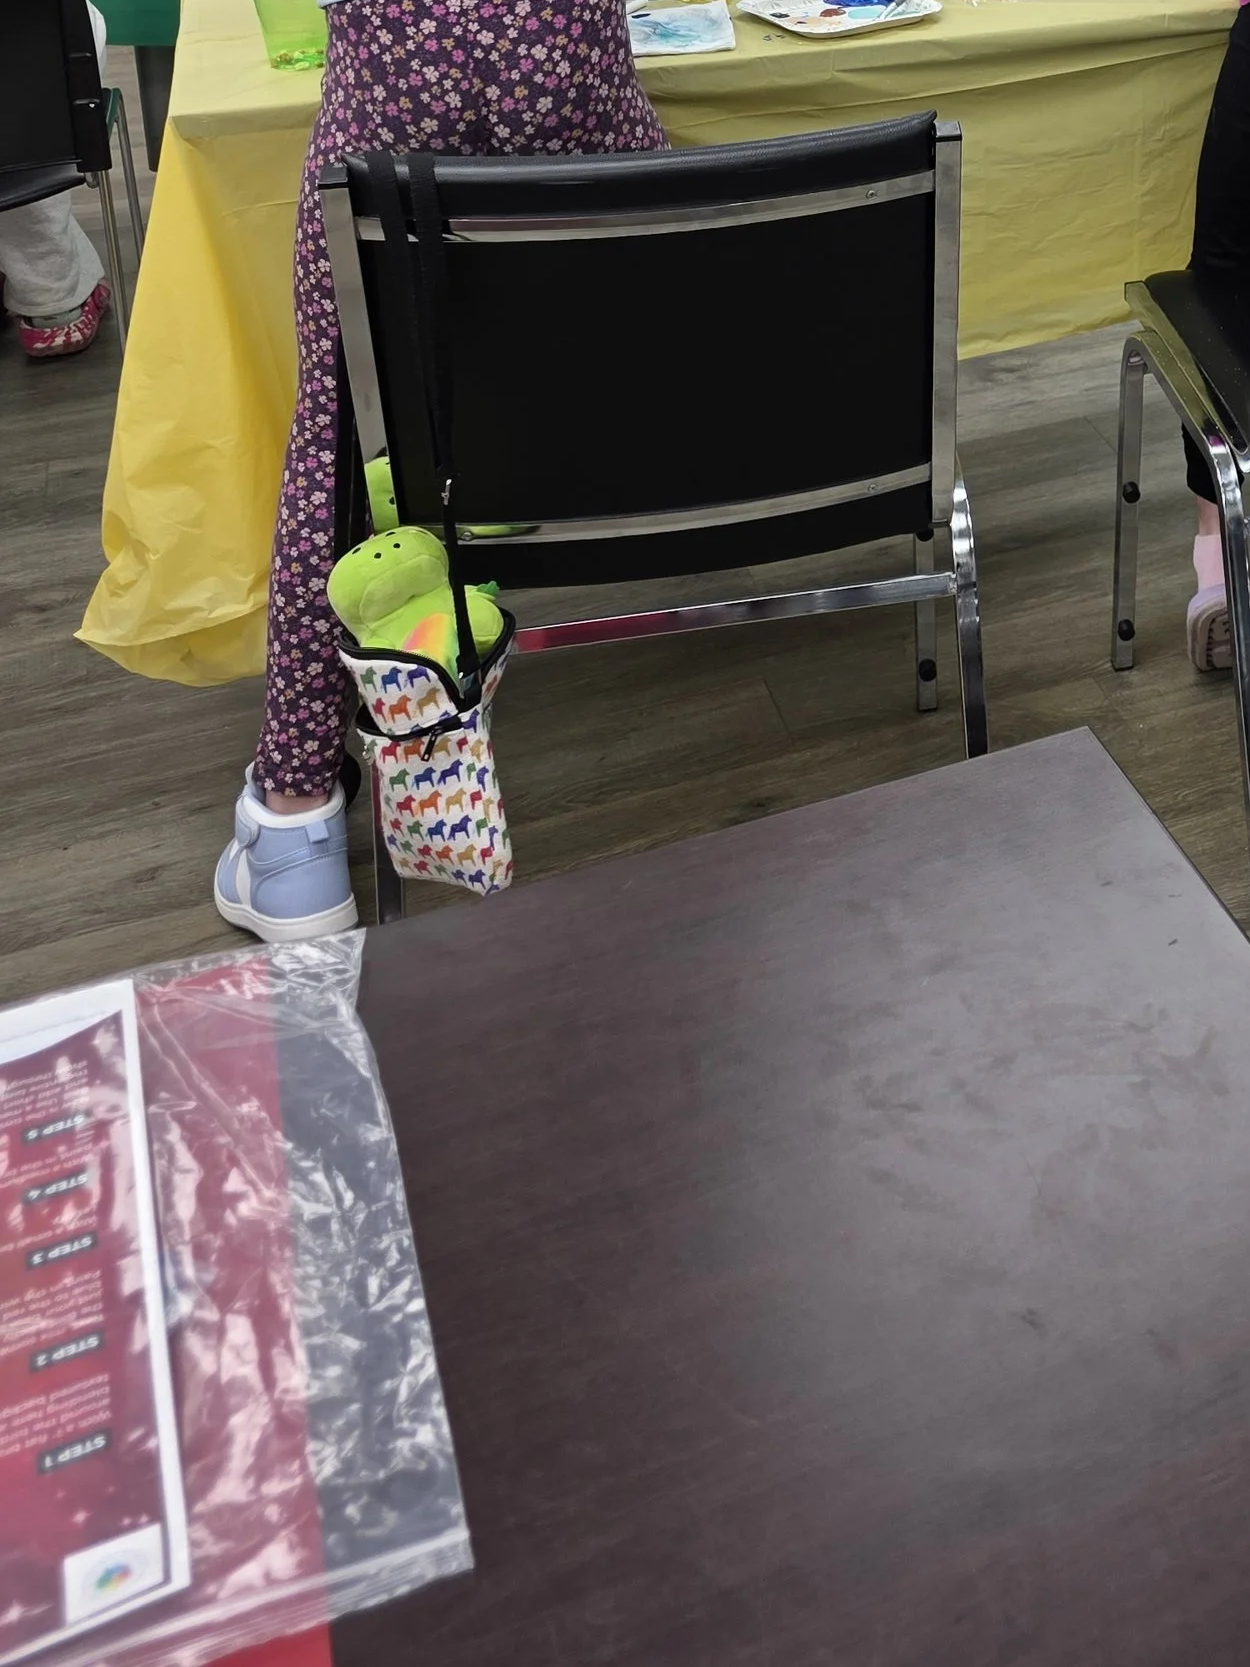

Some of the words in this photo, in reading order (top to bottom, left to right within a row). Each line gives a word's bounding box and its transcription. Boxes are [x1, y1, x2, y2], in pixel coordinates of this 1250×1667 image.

[42, 1114, 86, 1136] STEP
[26, 1128, 39, 1141] 5
[45, 1173, 88, 1196] STEP
[27, 1189, 42, 1201] 4
[47, 1236, 93, 1259] STEP
[31, 1251, 44, 1266] 3
[51, 1334, 99, 1361] STEP
[36, 1353, 48, 1367] 2
[58, 1435, 107, 1462] STEP
[44, 1455, 52, 1468] 1
